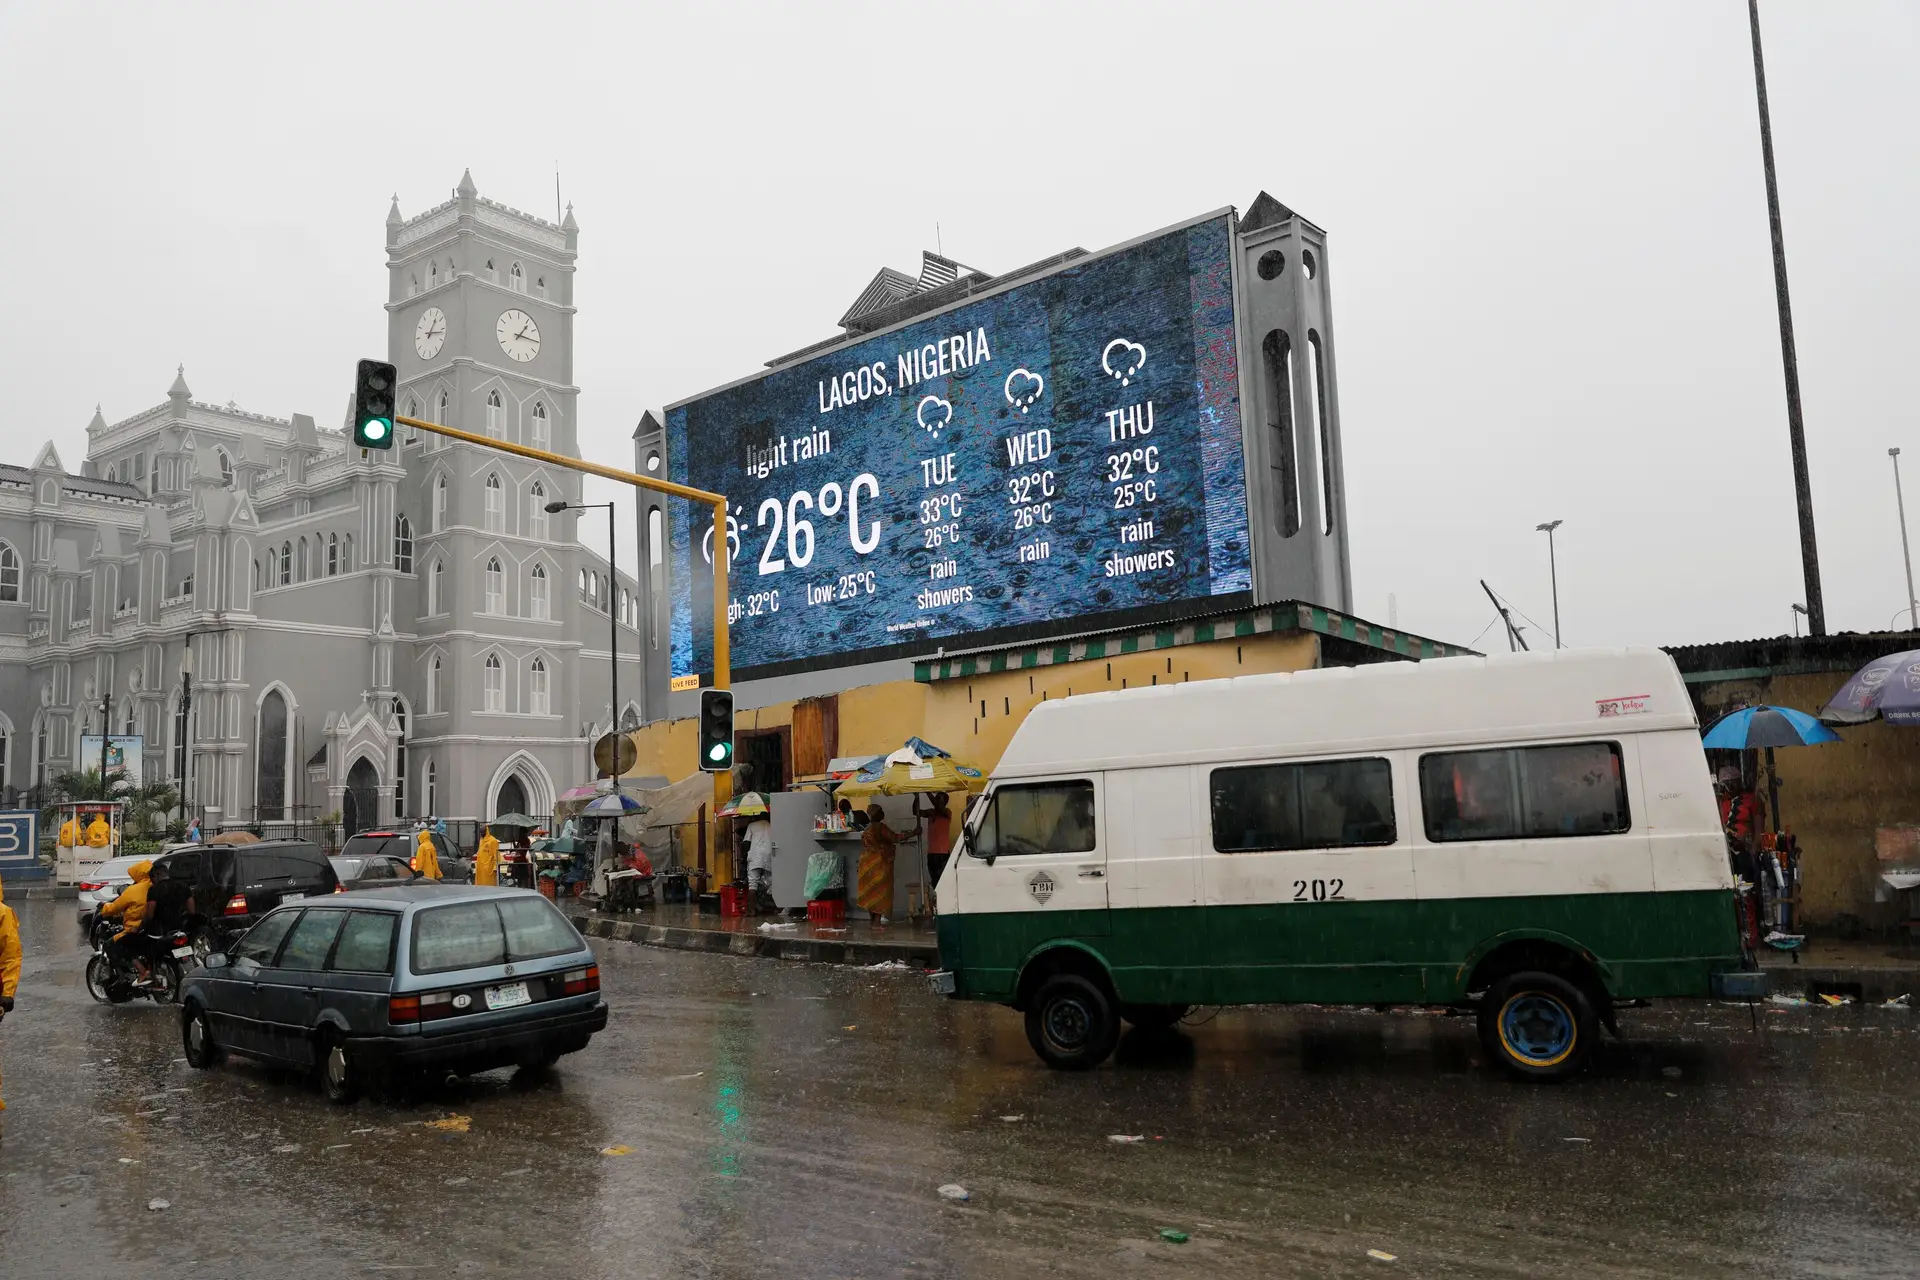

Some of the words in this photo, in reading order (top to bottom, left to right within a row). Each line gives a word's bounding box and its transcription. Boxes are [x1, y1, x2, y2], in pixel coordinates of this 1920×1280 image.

[819, 361, 893, 414] LAGOS,
[898, 326, 991, 389] NIGERIA
[1105, 401, 1154, 442] THU
[746, 436, 788, 479] light
[793, 425, 830, 463] rain
[1006, 428, 1052, 467] WED
[920, 452, 957, 488] TUE
[1107, 445, 1160, 483] 32°C
[1008, 470, 1055, 505] 32°C
[1113, 479, 1157, 510] 25°C
[757, 472, 881, 576] 26°C
[920, 492, 962, 525] 33°C
[1014, 502, 1052, 530] 26°C
[924, 522, 960, 549] 26°C
[1120, 517, 1154, 544] rain
[1020, 537, 1050, 563] rain
[1105, 549, 1175, 578] showers
[930, 556, 957, 580] rain
[747, 589, 780, 617] 32°C
[807, 582, 836, 606] Low:
[839, 570, 876, 600] 25°C
[917, 585, 973, 610] showers
[672, 680, 684, 688] LIVE
[685, 679, 698, 687] FEED
[1293, 878, 1345, 902] 202
